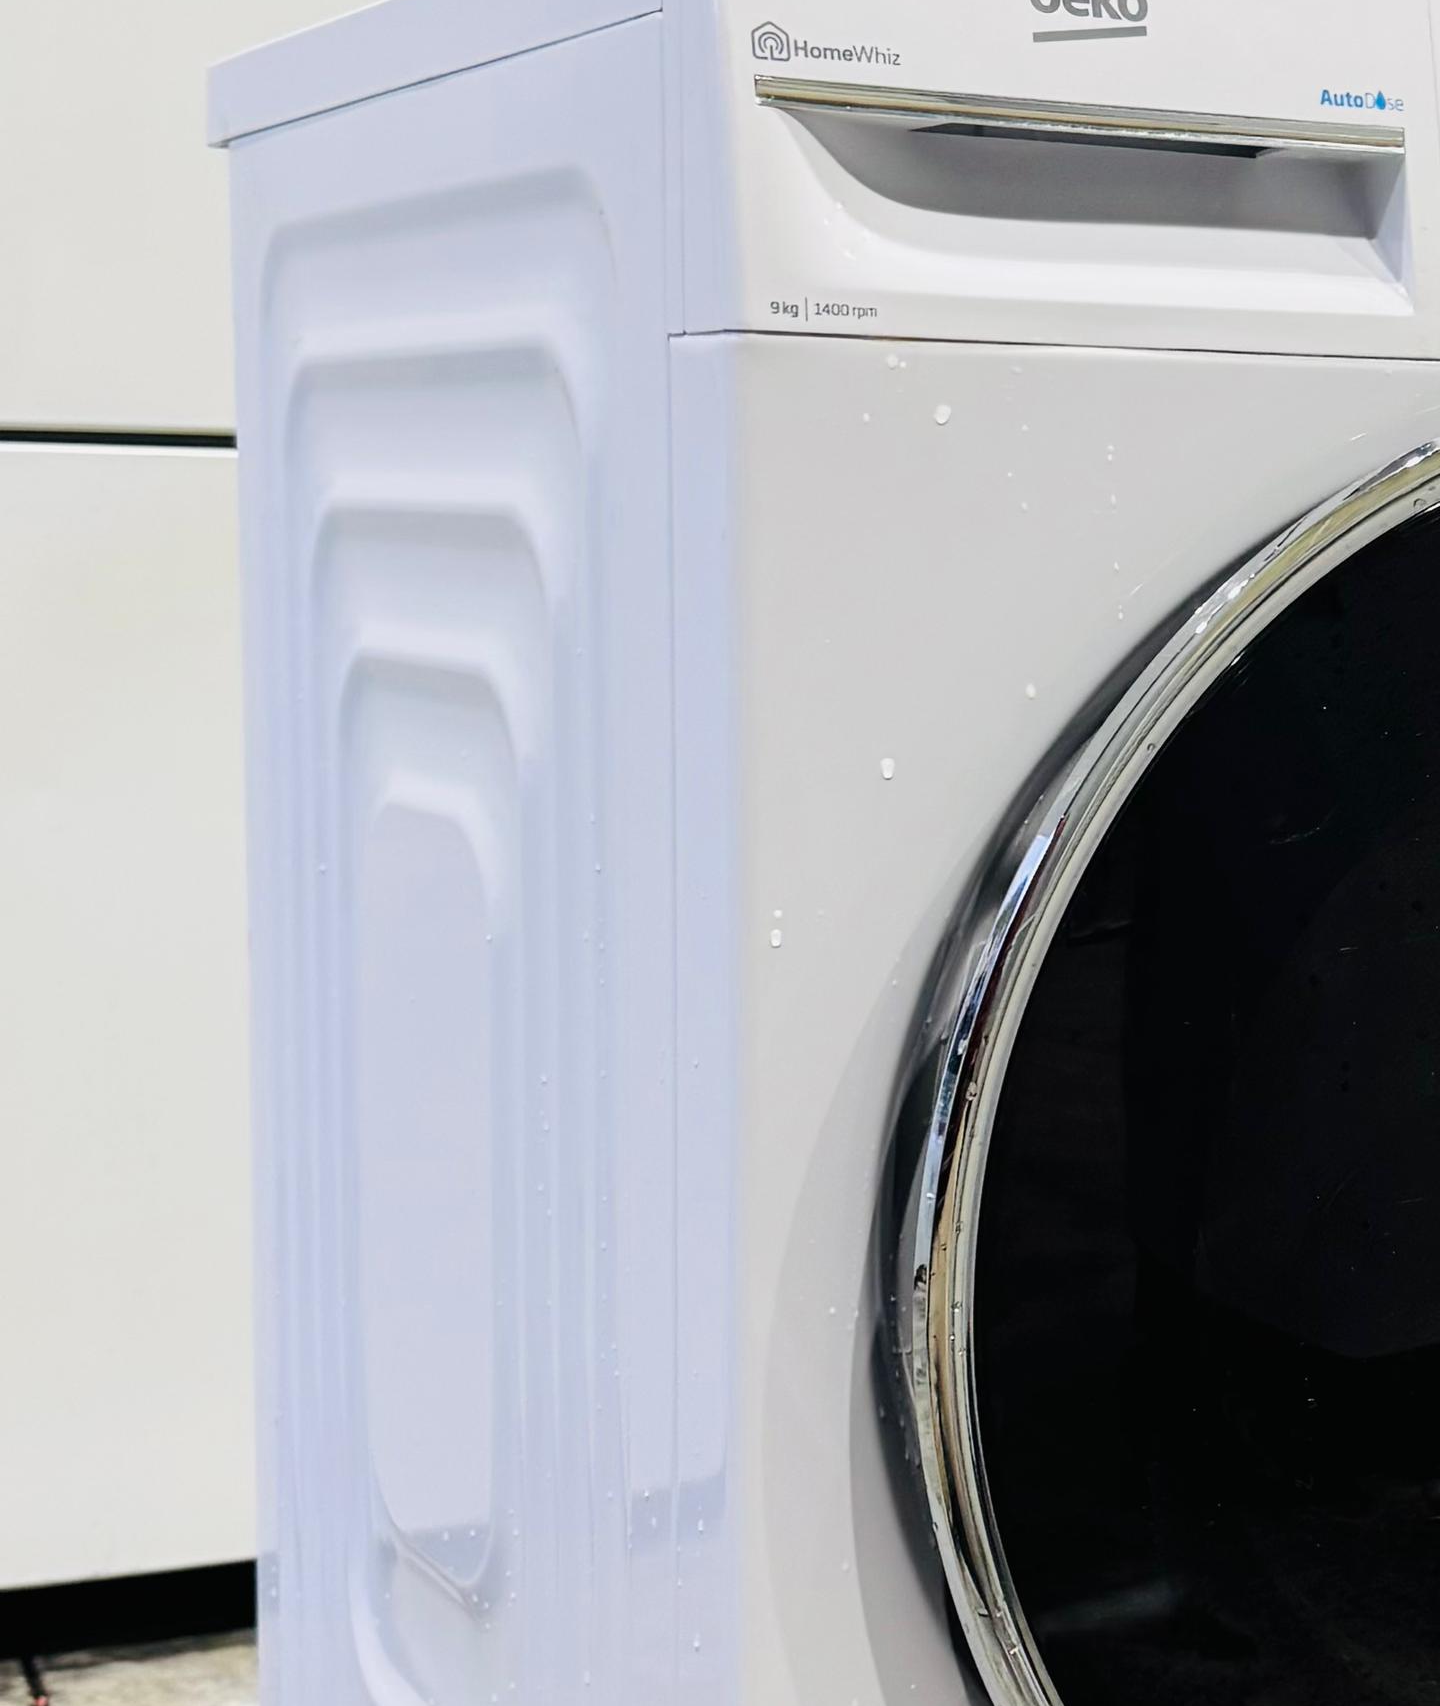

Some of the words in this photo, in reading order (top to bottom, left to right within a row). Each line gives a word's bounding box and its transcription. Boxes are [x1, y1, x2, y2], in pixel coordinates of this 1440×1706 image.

[794, 40, 901, 66] HomeWhiz
[814, 302, 850, 317] 1400
[853, 306, 878, 320] rpm
